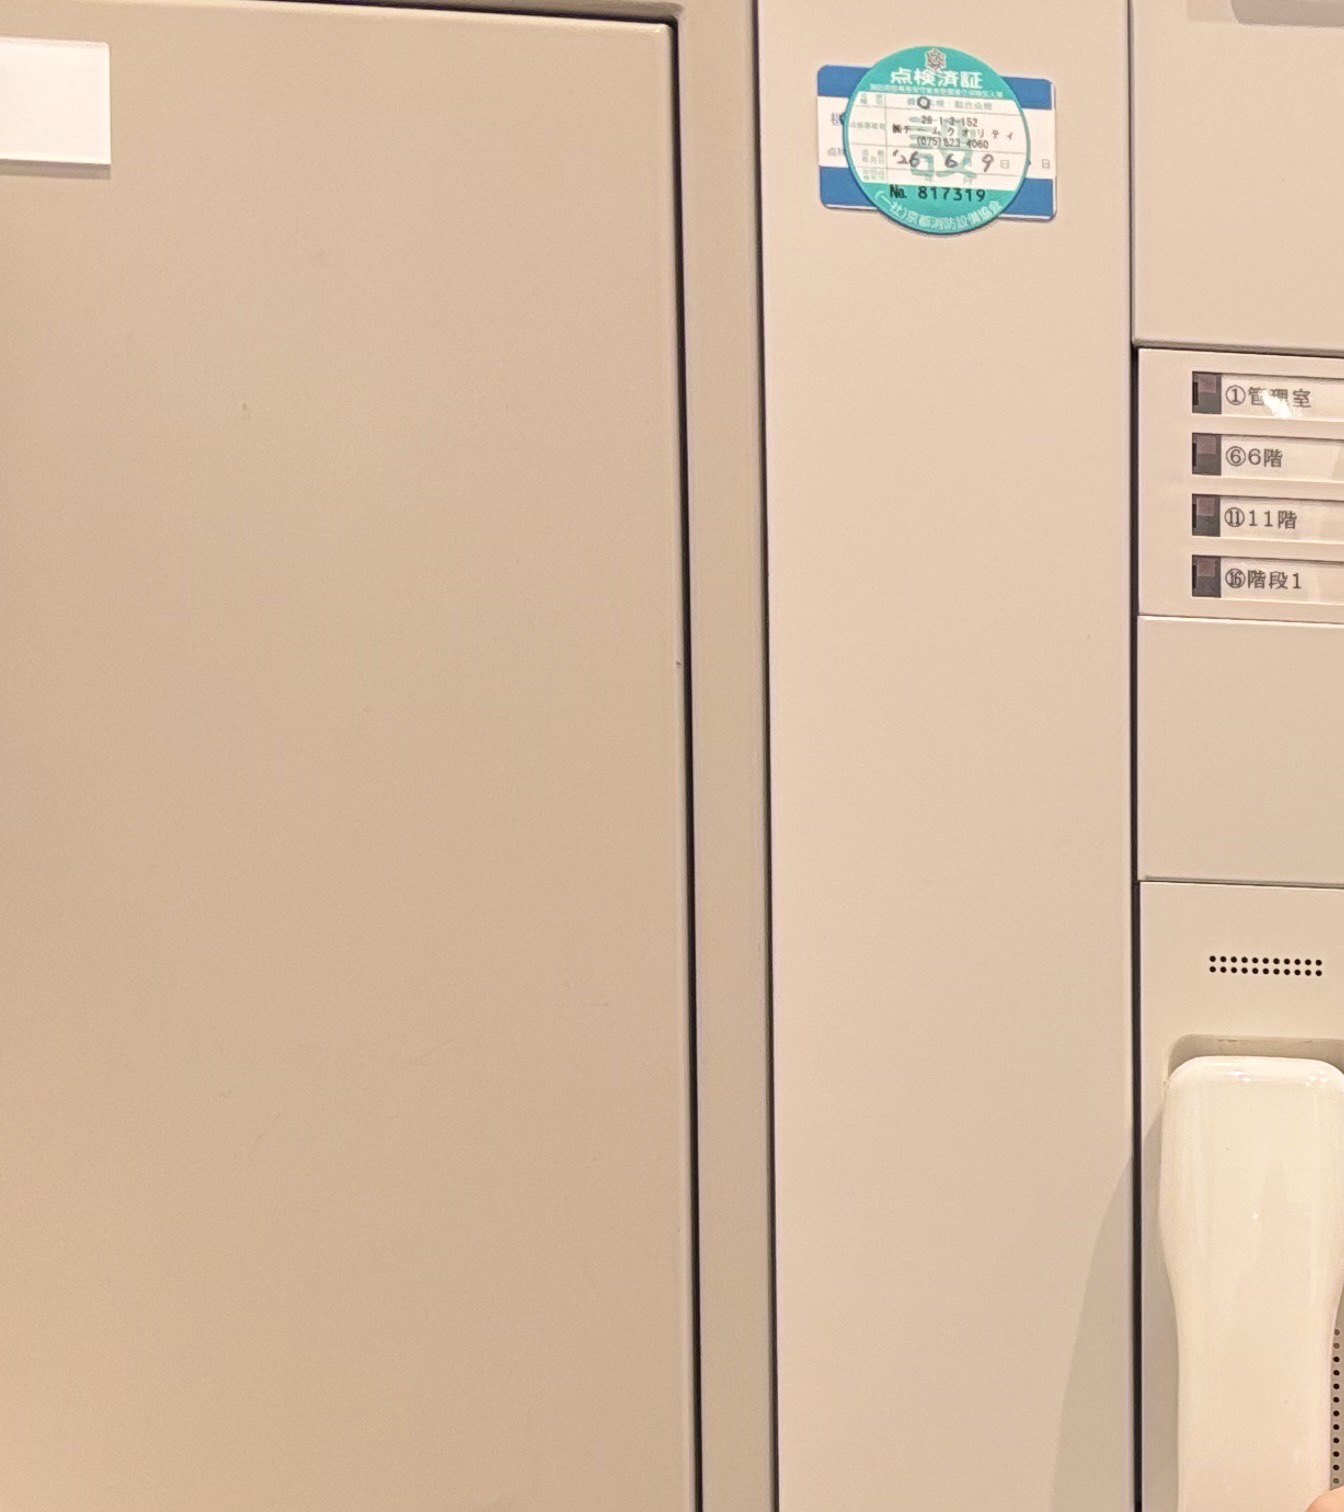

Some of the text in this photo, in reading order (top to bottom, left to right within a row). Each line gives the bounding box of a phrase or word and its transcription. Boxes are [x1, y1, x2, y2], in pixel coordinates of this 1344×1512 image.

[890, 67, 983, 89] 点検済証
[945, 153, 995, 173] 6 9
[918, 185, 987, 202] 817319
